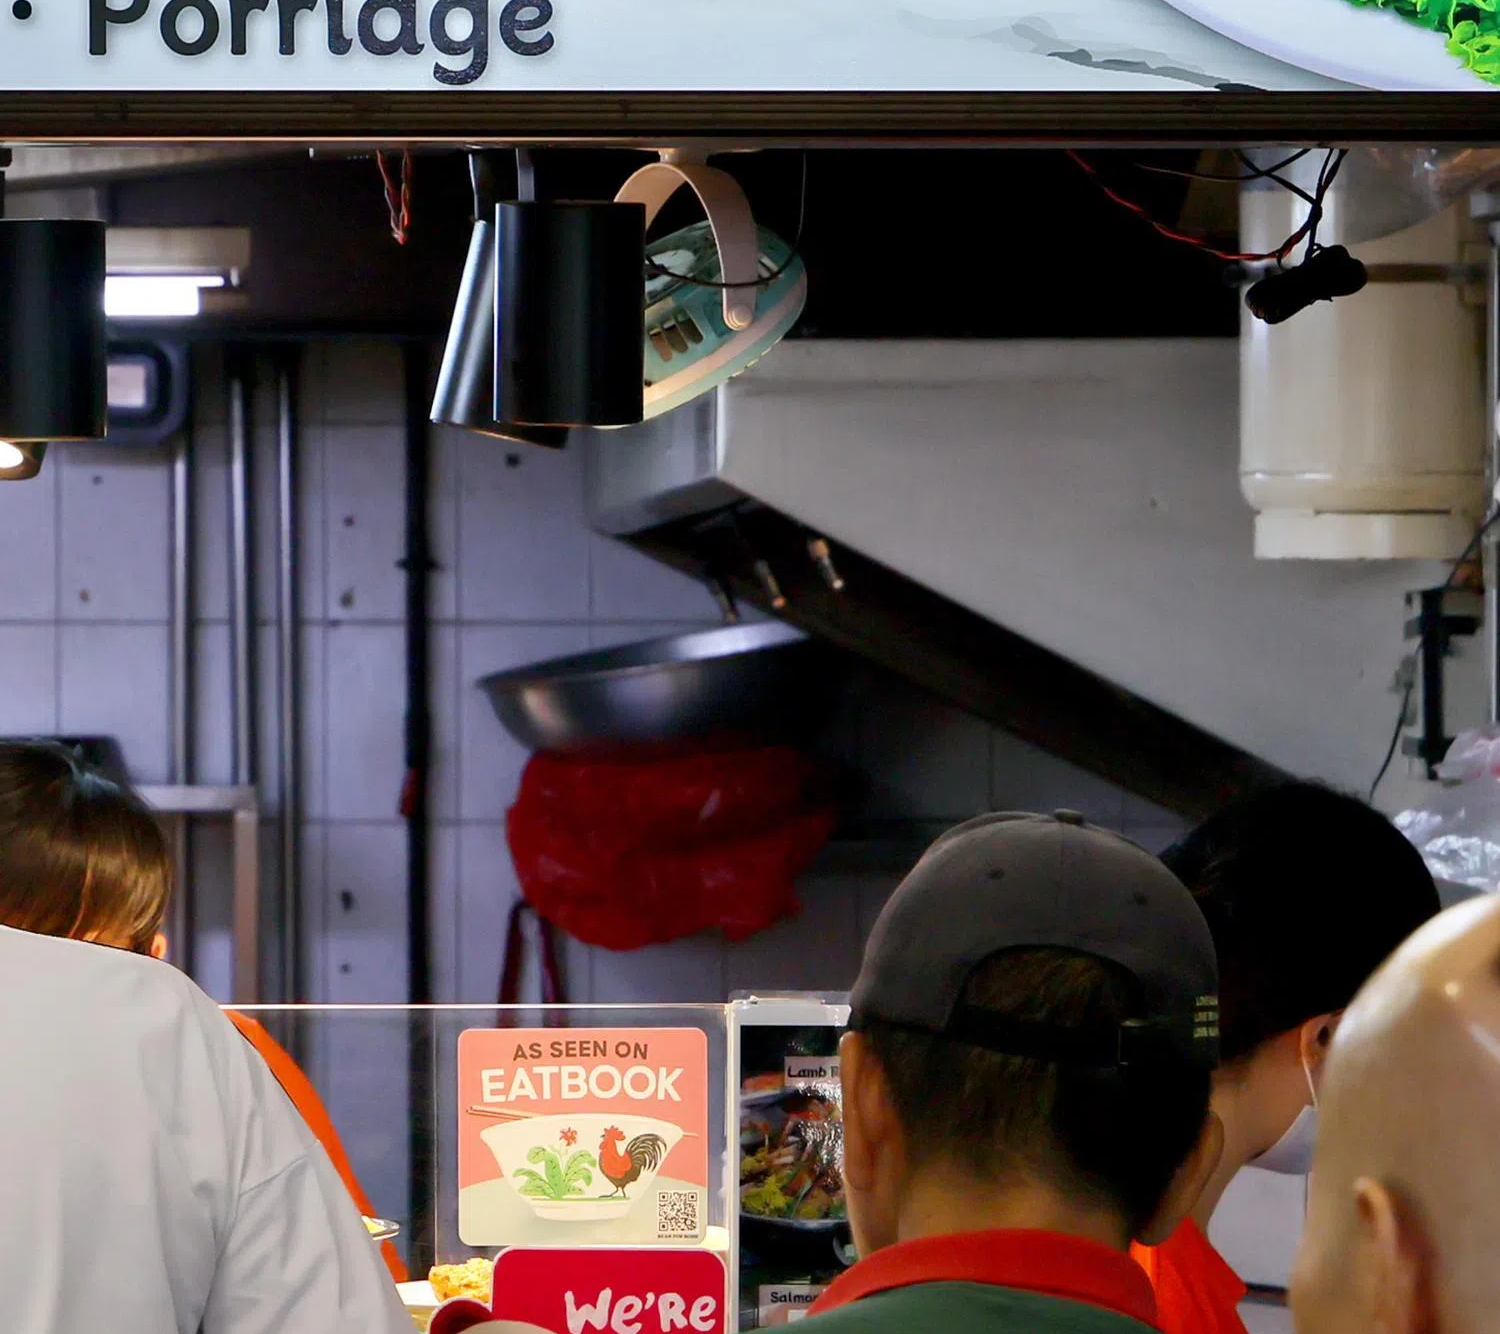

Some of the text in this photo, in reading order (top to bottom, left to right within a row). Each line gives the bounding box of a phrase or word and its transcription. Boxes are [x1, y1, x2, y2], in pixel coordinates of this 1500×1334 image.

[513, 1041, 649, 1062] AS SEEN ON
[788, 1066, 827, 1078] Lamb
[480, 1064, 684, 1104] EATBOOK
